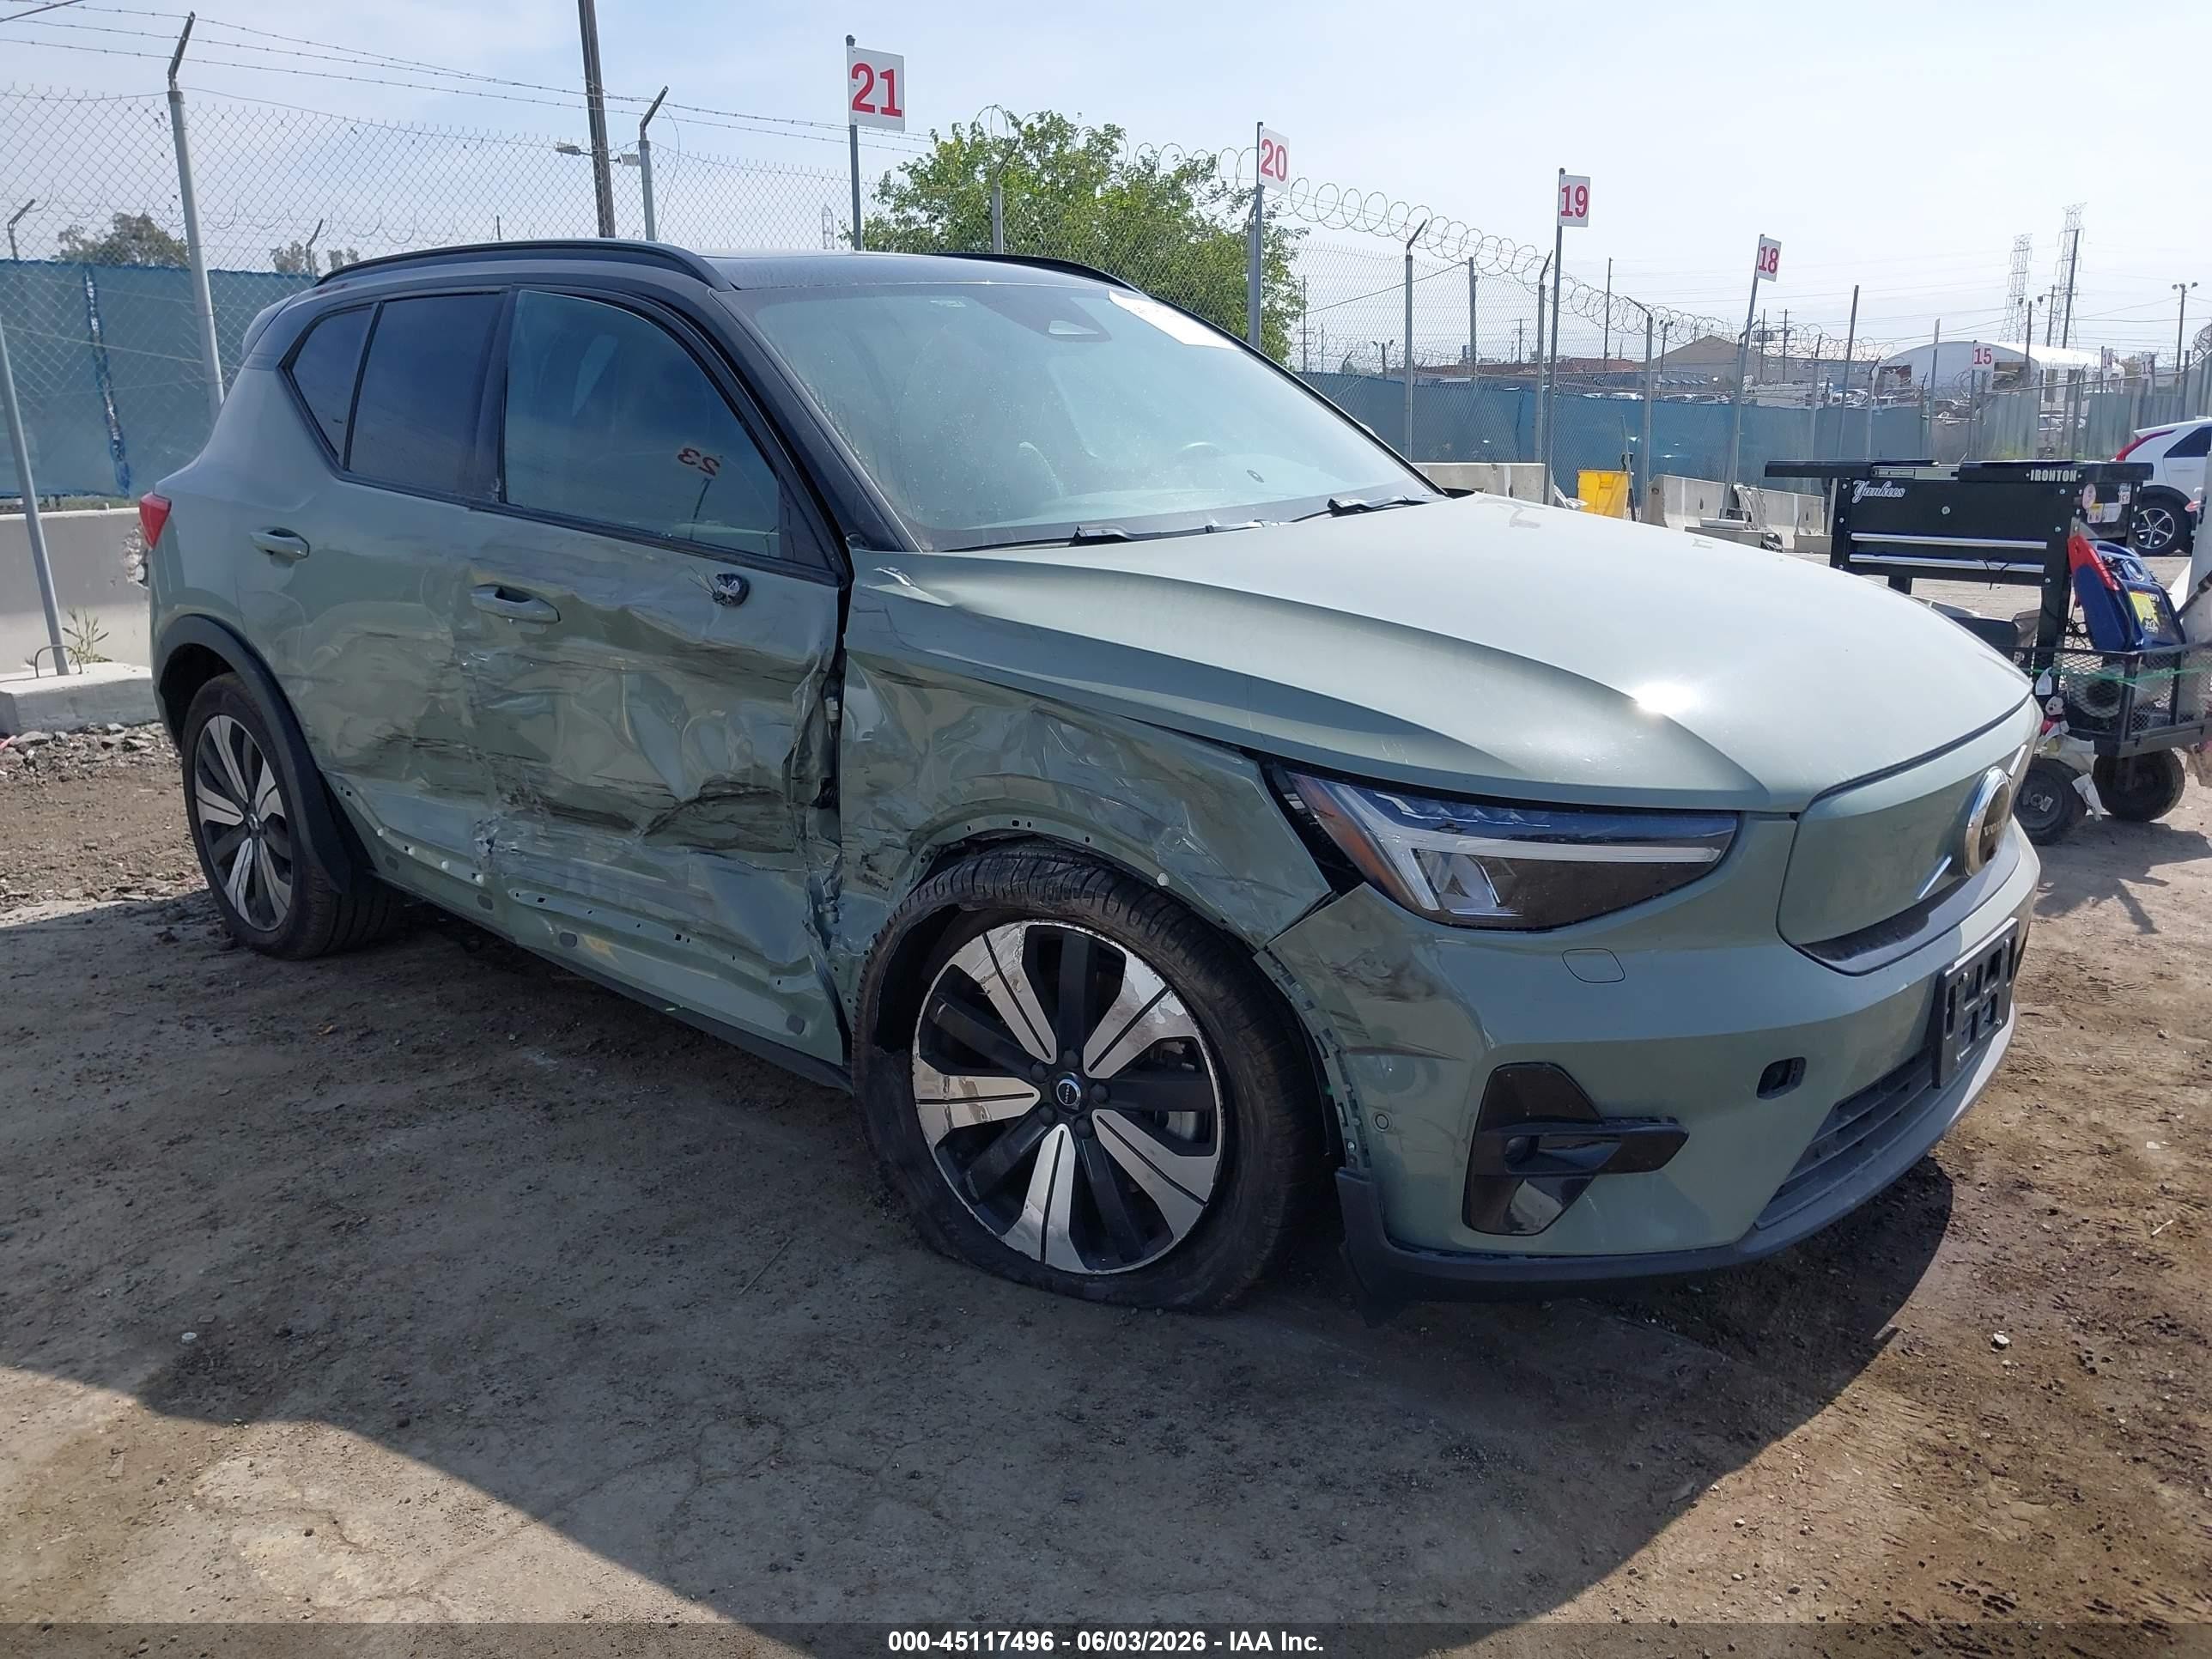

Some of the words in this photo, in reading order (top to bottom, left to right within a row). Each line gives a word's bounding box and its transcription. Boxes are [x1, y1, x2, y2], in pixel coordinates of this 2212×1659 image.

[851, 63, 902, 118] 21
[1261, 138, 1287, 182] 20
[1560, 185, 1589, 218] 19
[1758, 246, 1779, 274] 18
[1973, 347, 1993, 365] 15
[2102, 352, 2113, 368] 14
[2030, 469, 2077, 482] IRONTON
[1851, 480, 1905, 504] Yankees
